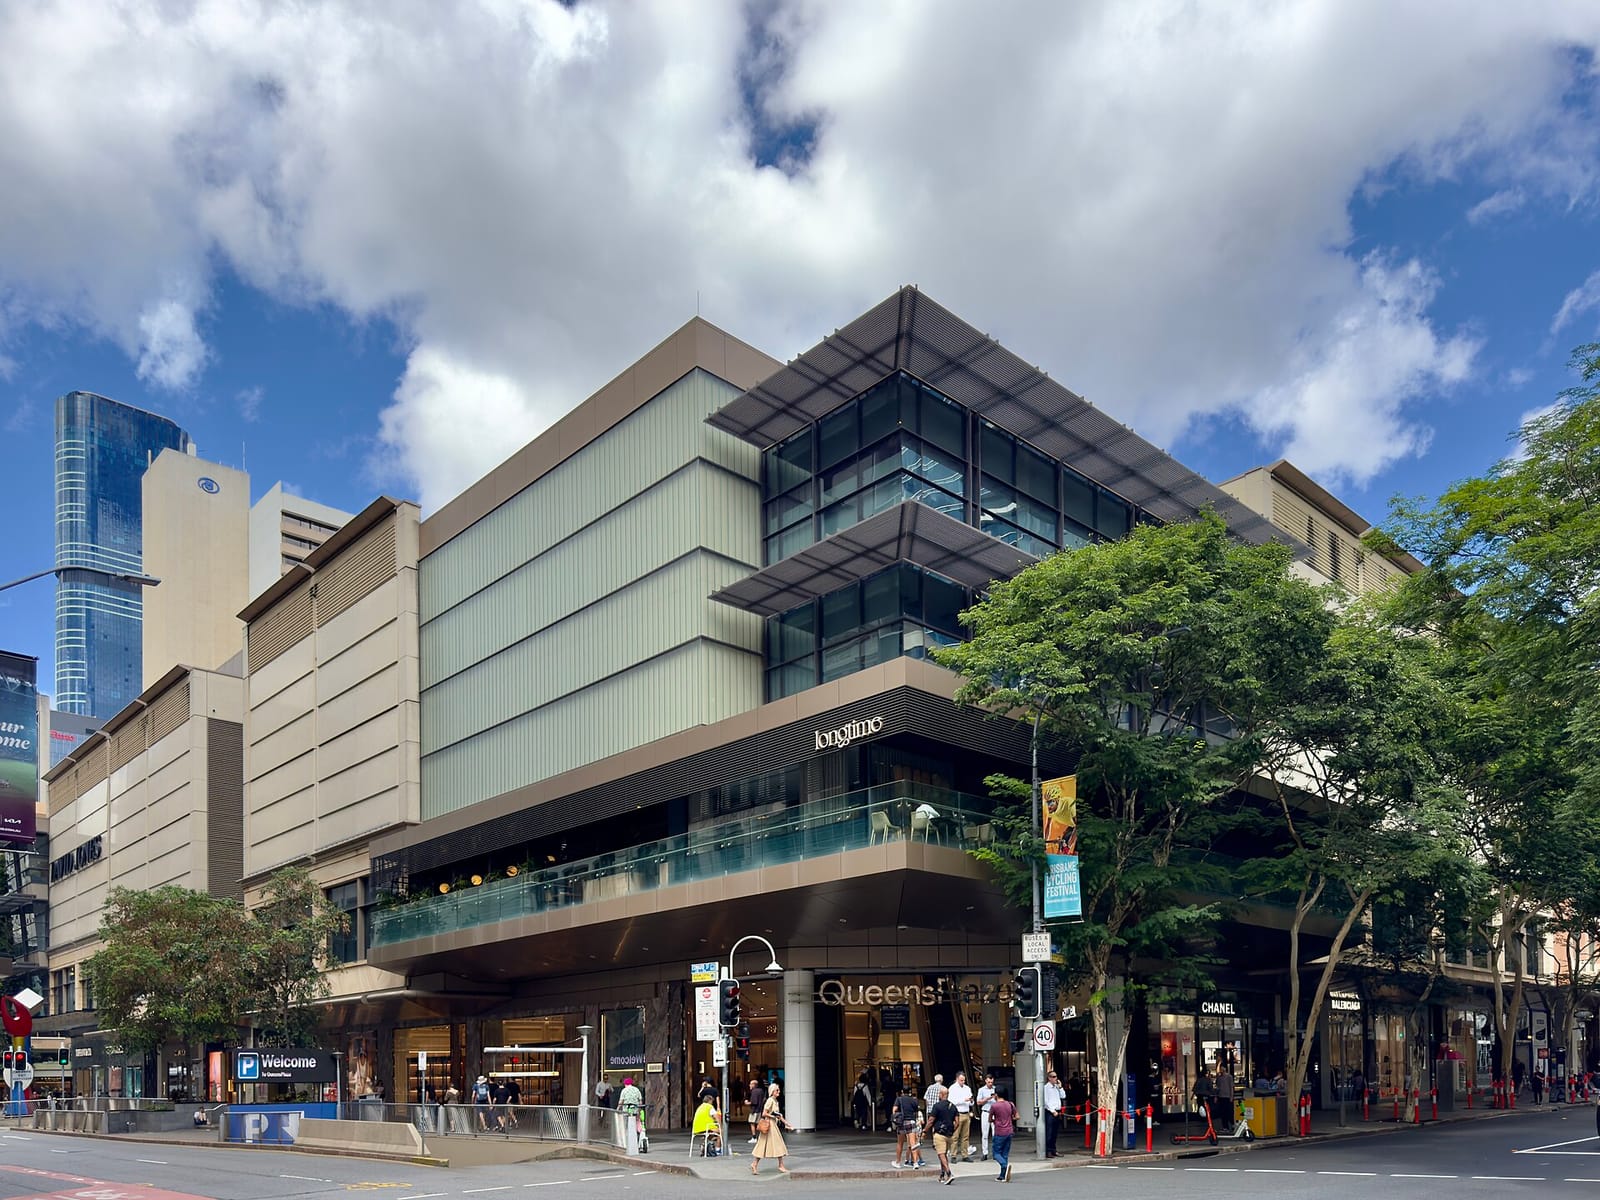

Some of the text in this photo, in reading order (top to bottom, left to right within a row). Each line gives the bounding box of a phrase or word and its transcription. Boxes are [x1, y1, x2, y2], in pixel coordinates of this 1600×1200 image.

[815, 717, 883, 750] longtime
[1046, 872, 1077, 887] CYCLING
[1046, 884, 1078, 898] FESTIVAL
[819, 976, 1014, 1006] QueensPaza
[1201, 1002, 1236, 1015] CHANEL
[1037, 1030, 1051, 1041] 40
[242, 1054, 317, 1075] P Welcome
